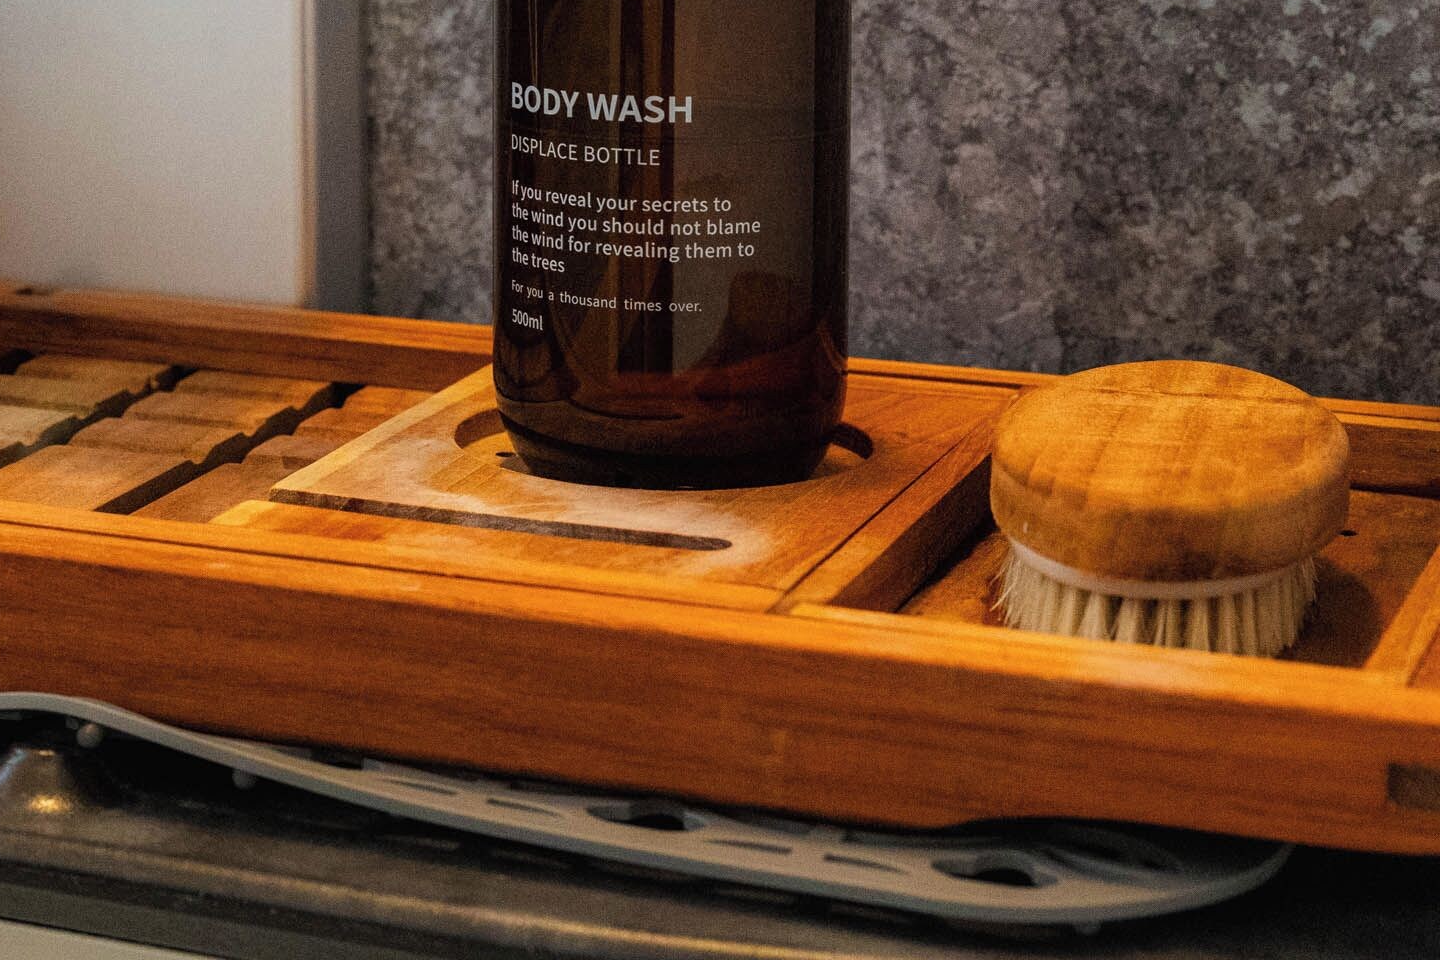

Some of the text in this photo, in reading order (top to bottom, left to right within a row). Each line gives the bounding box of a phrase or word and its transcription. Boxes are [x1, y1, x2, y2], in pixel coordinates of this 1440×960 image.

[511, 81, 693, 124] BODY WASH
[511, 134, 661, 166] DISPLACE BOTTLE
[512, 179, 732, 213] If you reveal your secrets to
[512, 202, 761, 236] the wind you should not blame
[512, 224, 755, 263] the wind for revealing them to
[512, 247, 566, 273] the trees
[511, 279, 703, 313] For you a thousand times over.
[511, 308, 544, 331] 500ml
